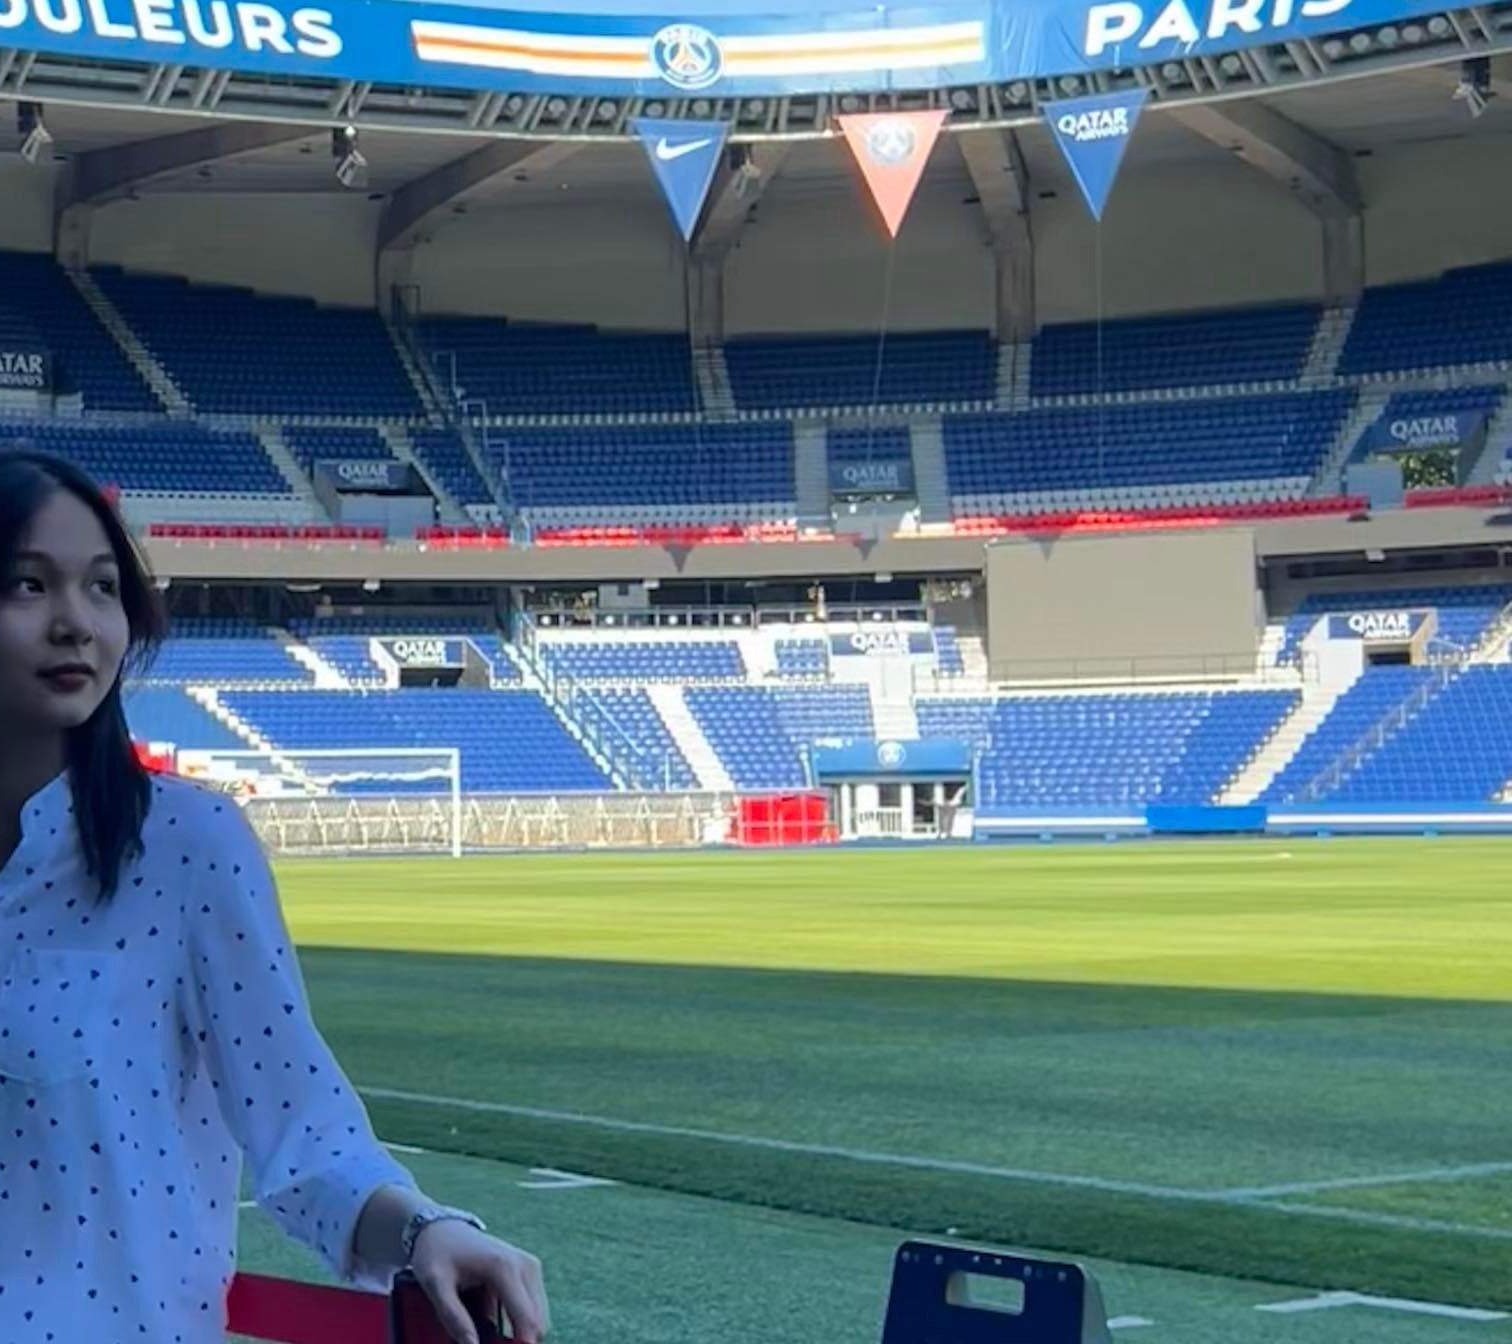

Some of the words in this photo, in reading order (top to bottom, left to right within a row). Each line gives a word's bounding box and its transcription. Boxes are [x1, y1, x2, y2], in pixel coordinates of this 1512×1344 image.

[1058, 107, 1128, 135] QATAR
[1390, 416, 1456, 440] QATAR
[338, 463, 388, 480] QATAR
[843, 464, 898, 484] QATAR
[1349, 612, 1409, 633] QATAR
[393, 640, 446, 659] QATAR
